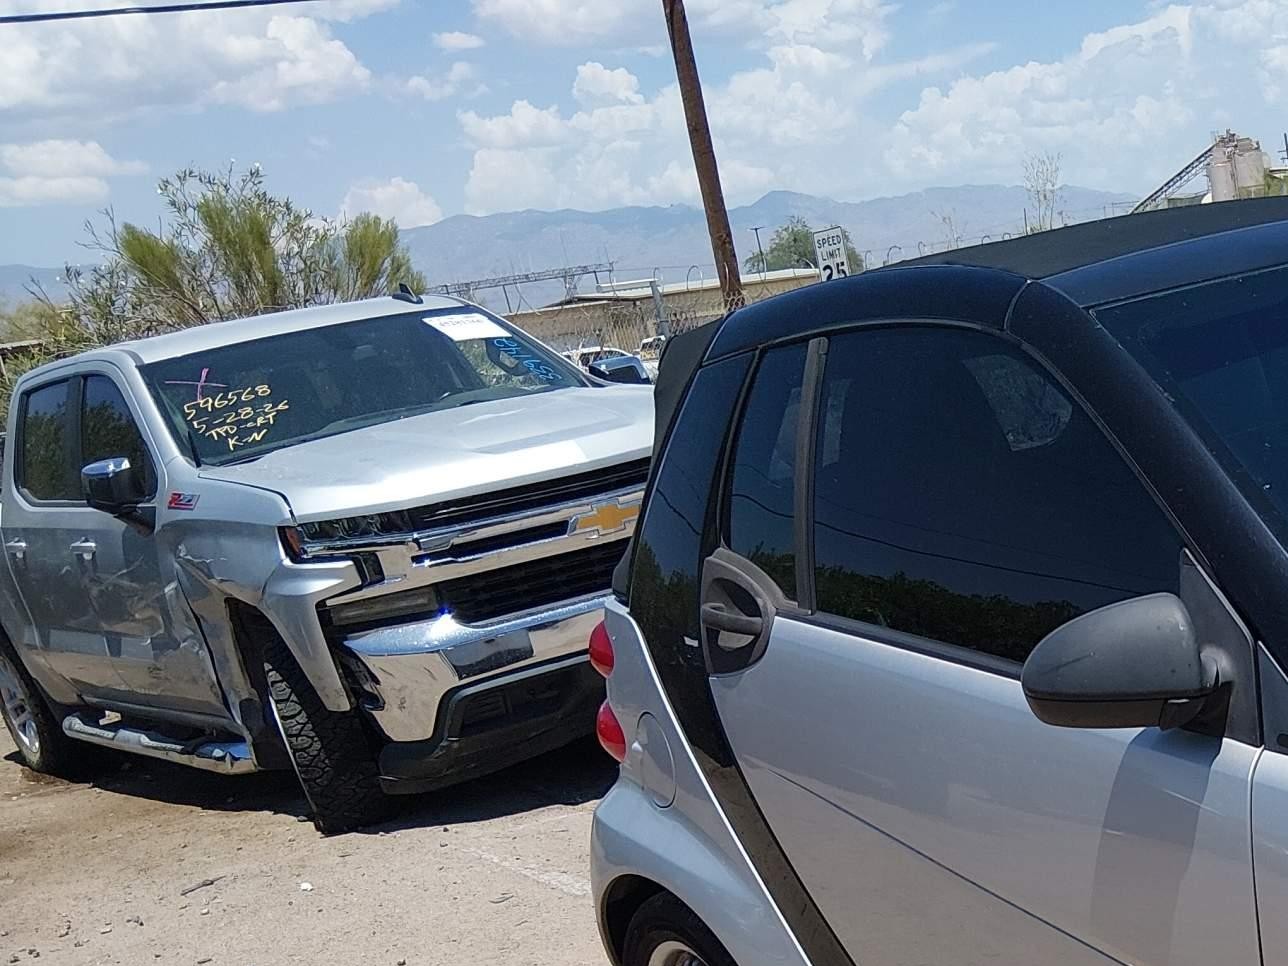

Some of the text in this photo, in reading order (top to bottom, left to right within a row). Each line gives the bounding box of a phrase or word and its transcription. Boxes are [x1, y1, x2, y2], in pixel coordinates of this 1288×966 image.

[817, 235, 841, 249] SPEED
[821, 248, 841, 261] LIMIT
[183, 384, 271, 420] 596568
[193, 400, 290, 433] 5-28-26
